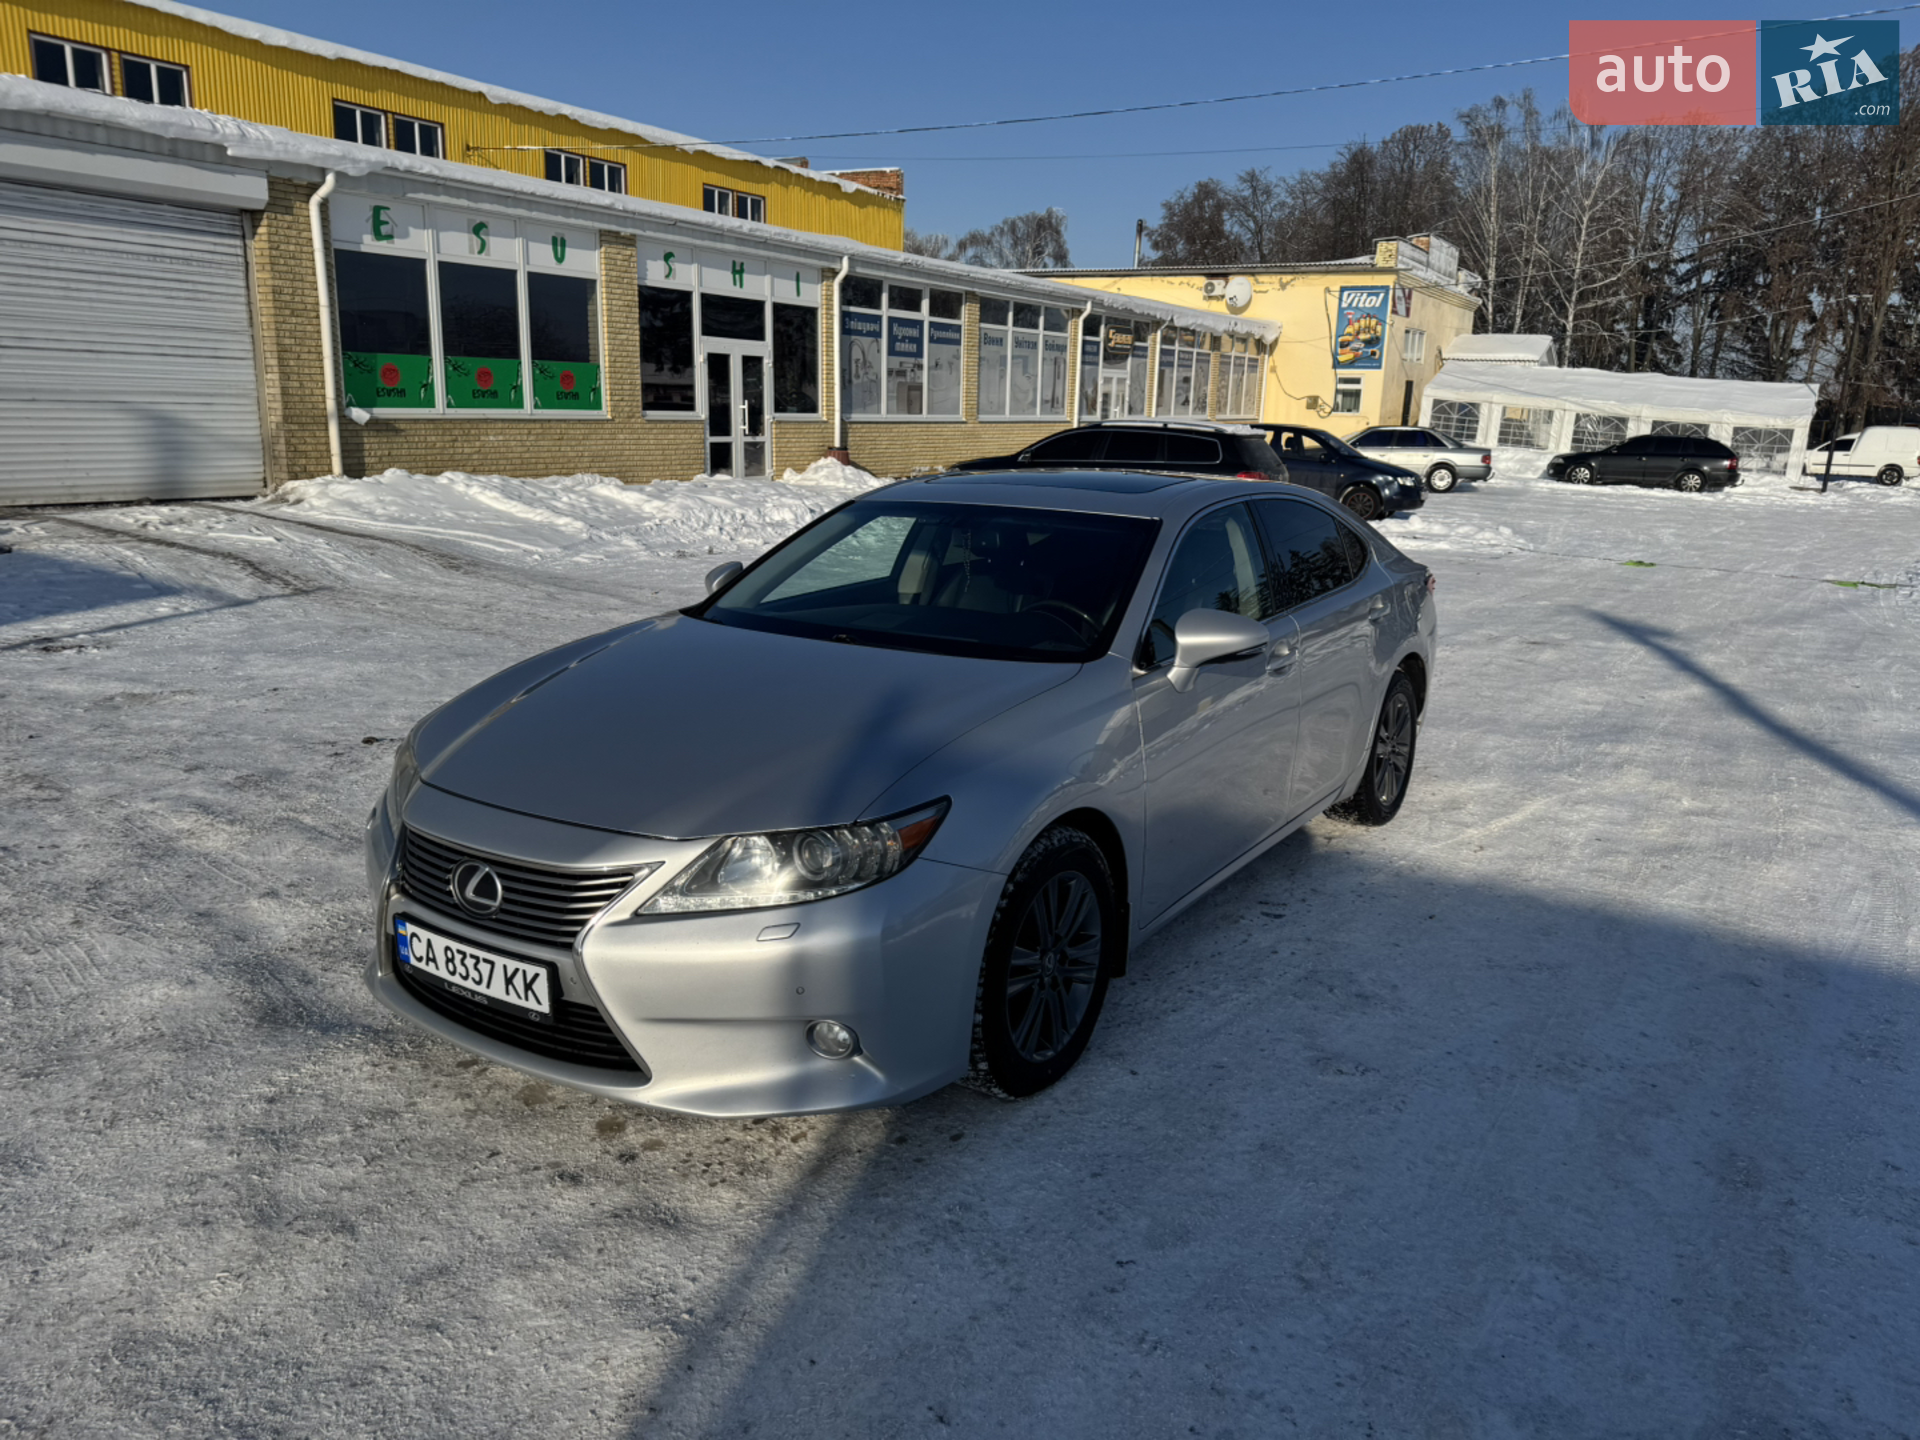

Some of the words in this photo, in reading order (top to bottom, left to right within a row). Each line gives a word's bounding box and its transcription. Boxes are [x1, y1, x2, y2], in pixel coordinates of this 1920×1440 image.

[1341, 290, 1386, 308] Vitol
[893, 322, 920, 340] Кухонні
[983, 332, 1003, 347] Ванни
[1014, 335, 1037, 350] Унітази
[409, 931, 440, 971] CA
[444, 945, 496, 990] 8337
[503, 963, 543, 1006] KK
[444, 981, 489, 1005] LEXUS
